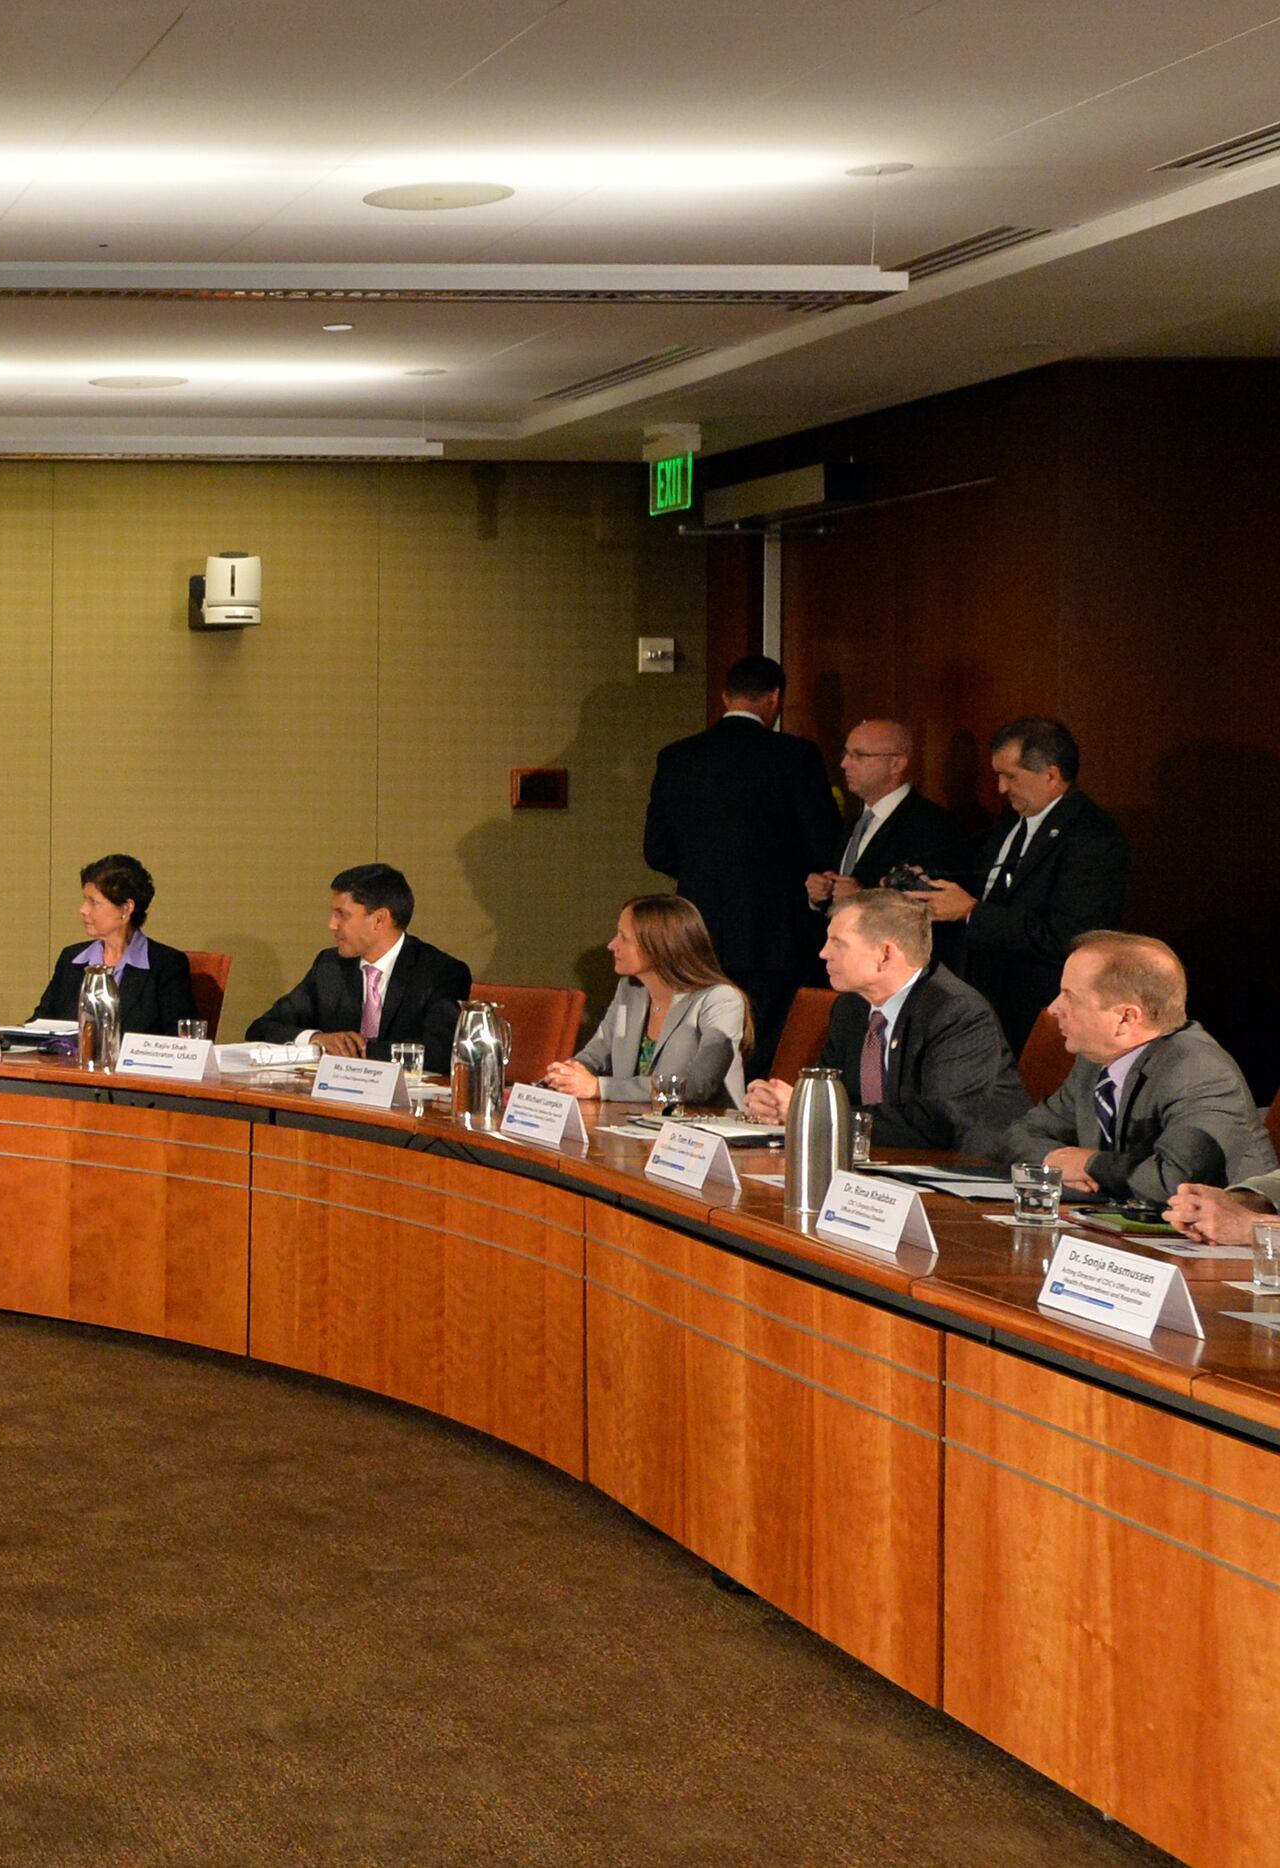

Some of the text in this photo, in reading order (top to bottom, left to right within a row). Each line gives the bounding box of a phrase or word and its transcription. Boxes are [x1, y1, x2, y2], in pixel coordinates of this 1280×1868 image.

[657, 457, 683, 508] EXIT
[154, 1041, 170, 1050] Rajiv
[171, 1043, 188, 1051] Shah
[176, 1053, 198, 1061] USAID
[345, 1064, 363, 1073] Sherri
[363, 1066, 384, 1077] Berger
[843, 1182, 853, 1194] Dr.
[854, 1185, 870, 1198] Rima
[1068, 1250, 1155, 1284] Dr. Sonja Rasmussen
